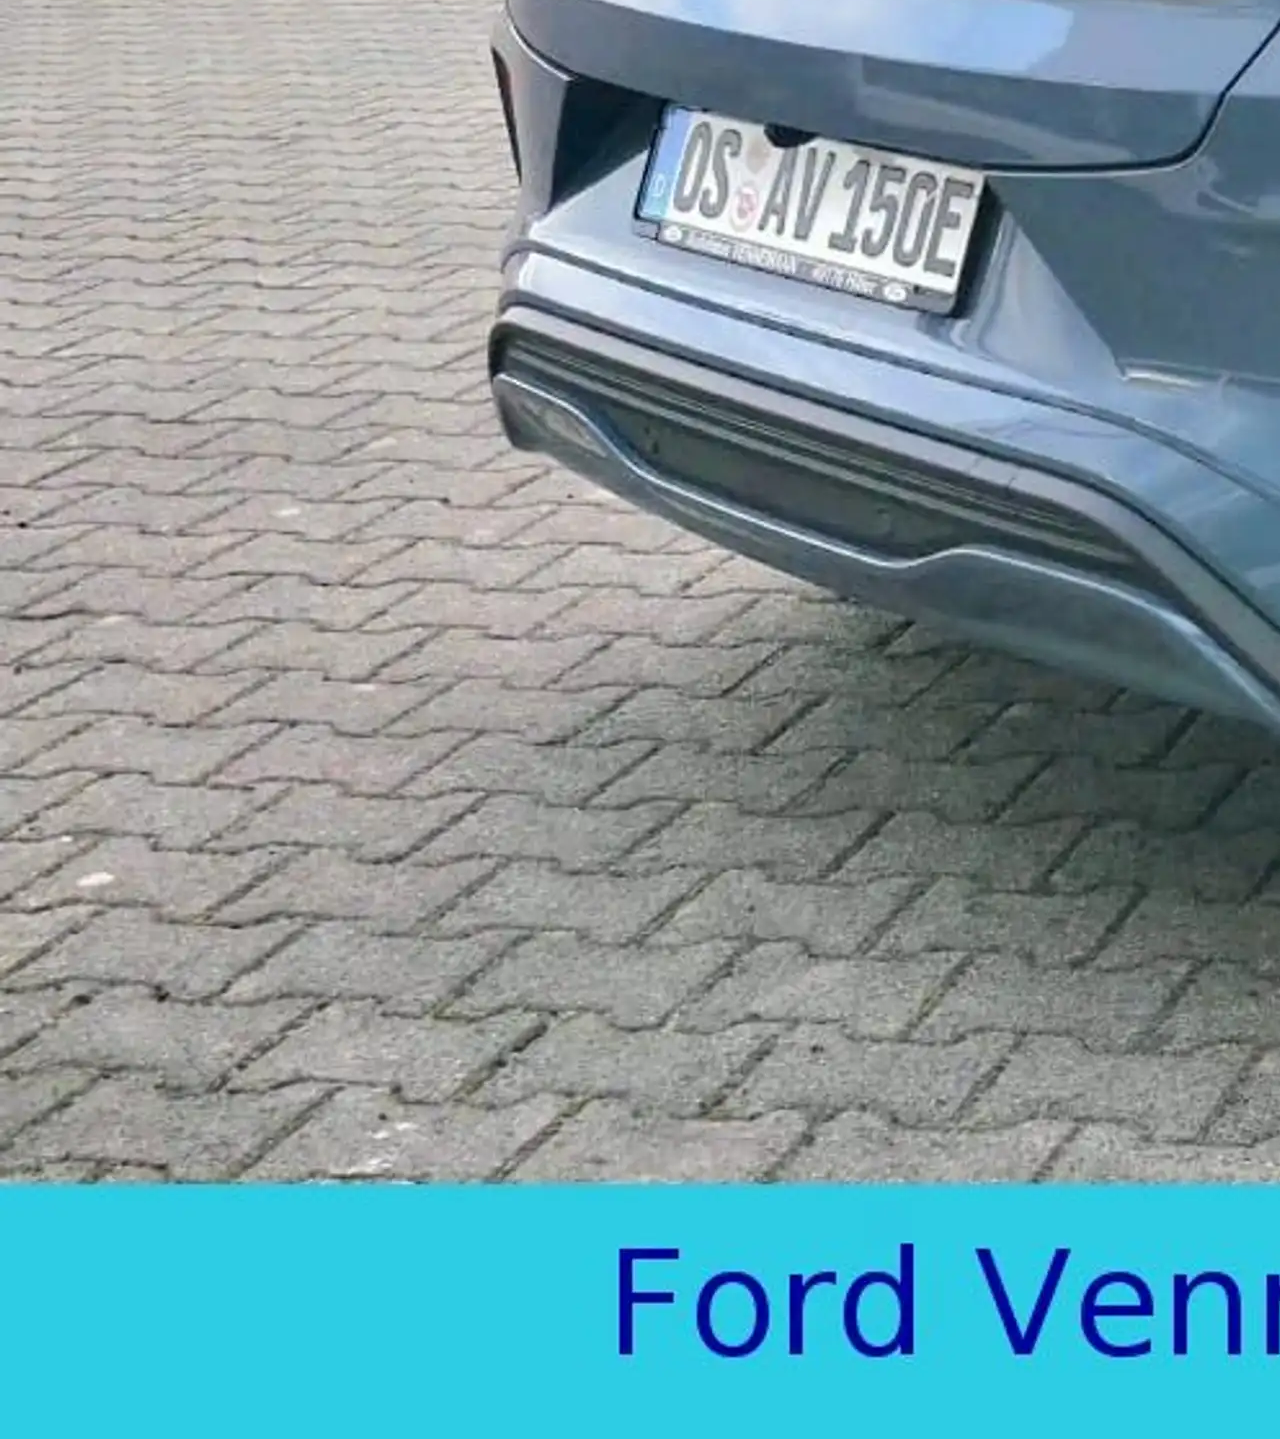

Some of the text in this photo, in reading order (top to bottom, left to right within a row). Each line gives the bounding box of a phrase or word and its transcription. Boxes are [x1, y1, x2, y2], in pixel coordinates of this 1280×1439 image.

[672, 120, 975, 278] OS AV 150E
